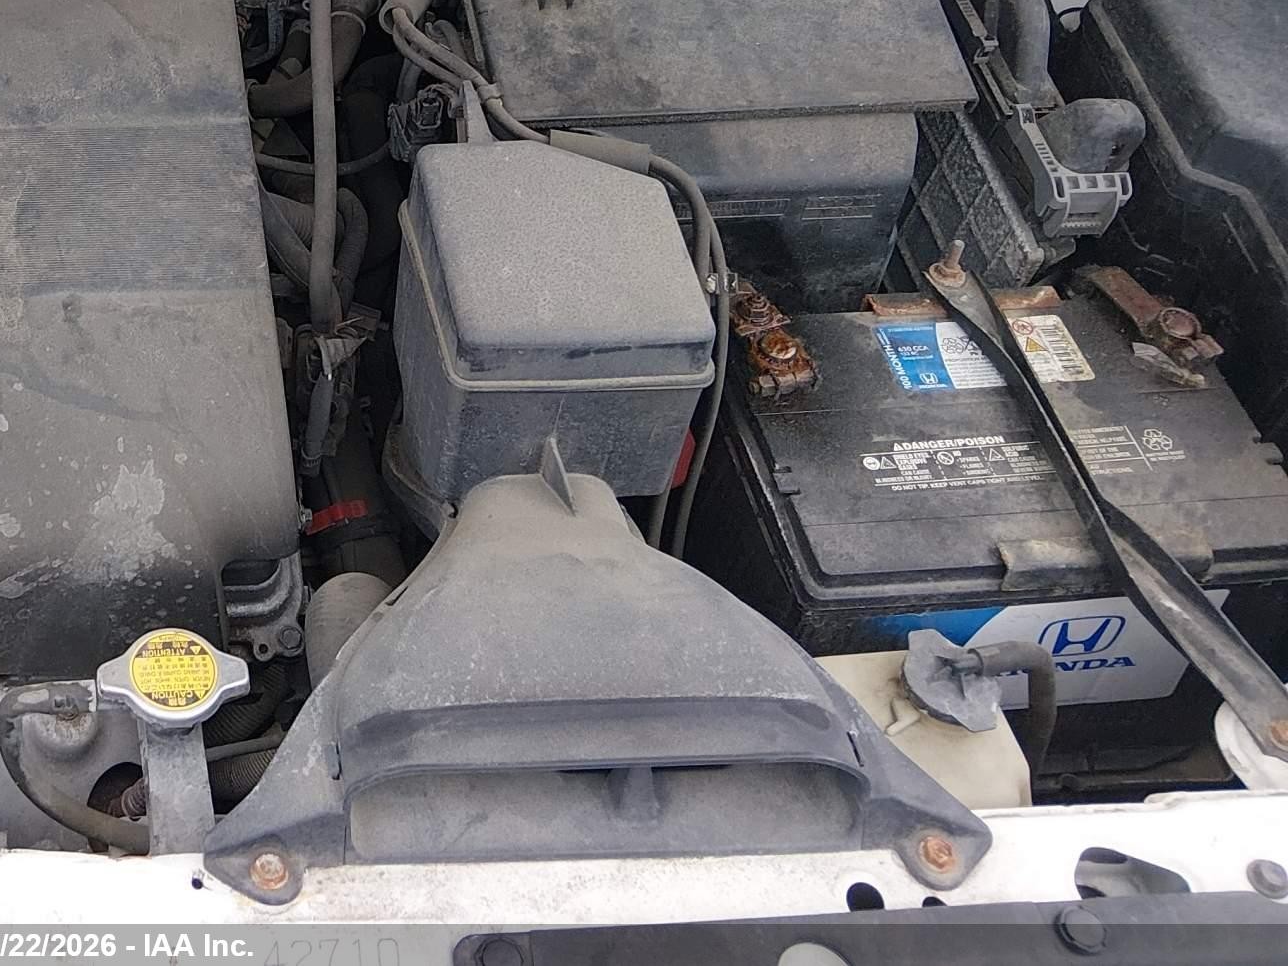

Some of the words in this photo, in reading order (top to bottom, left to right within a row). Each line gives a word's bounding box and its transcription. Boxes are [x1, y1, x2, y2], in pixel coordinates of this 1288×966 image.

[883, 345, 906, 375] MONTH
[902, 436, 1005, 450] DANGER/POISON
[152, 689, 193, 700] CAUTION
